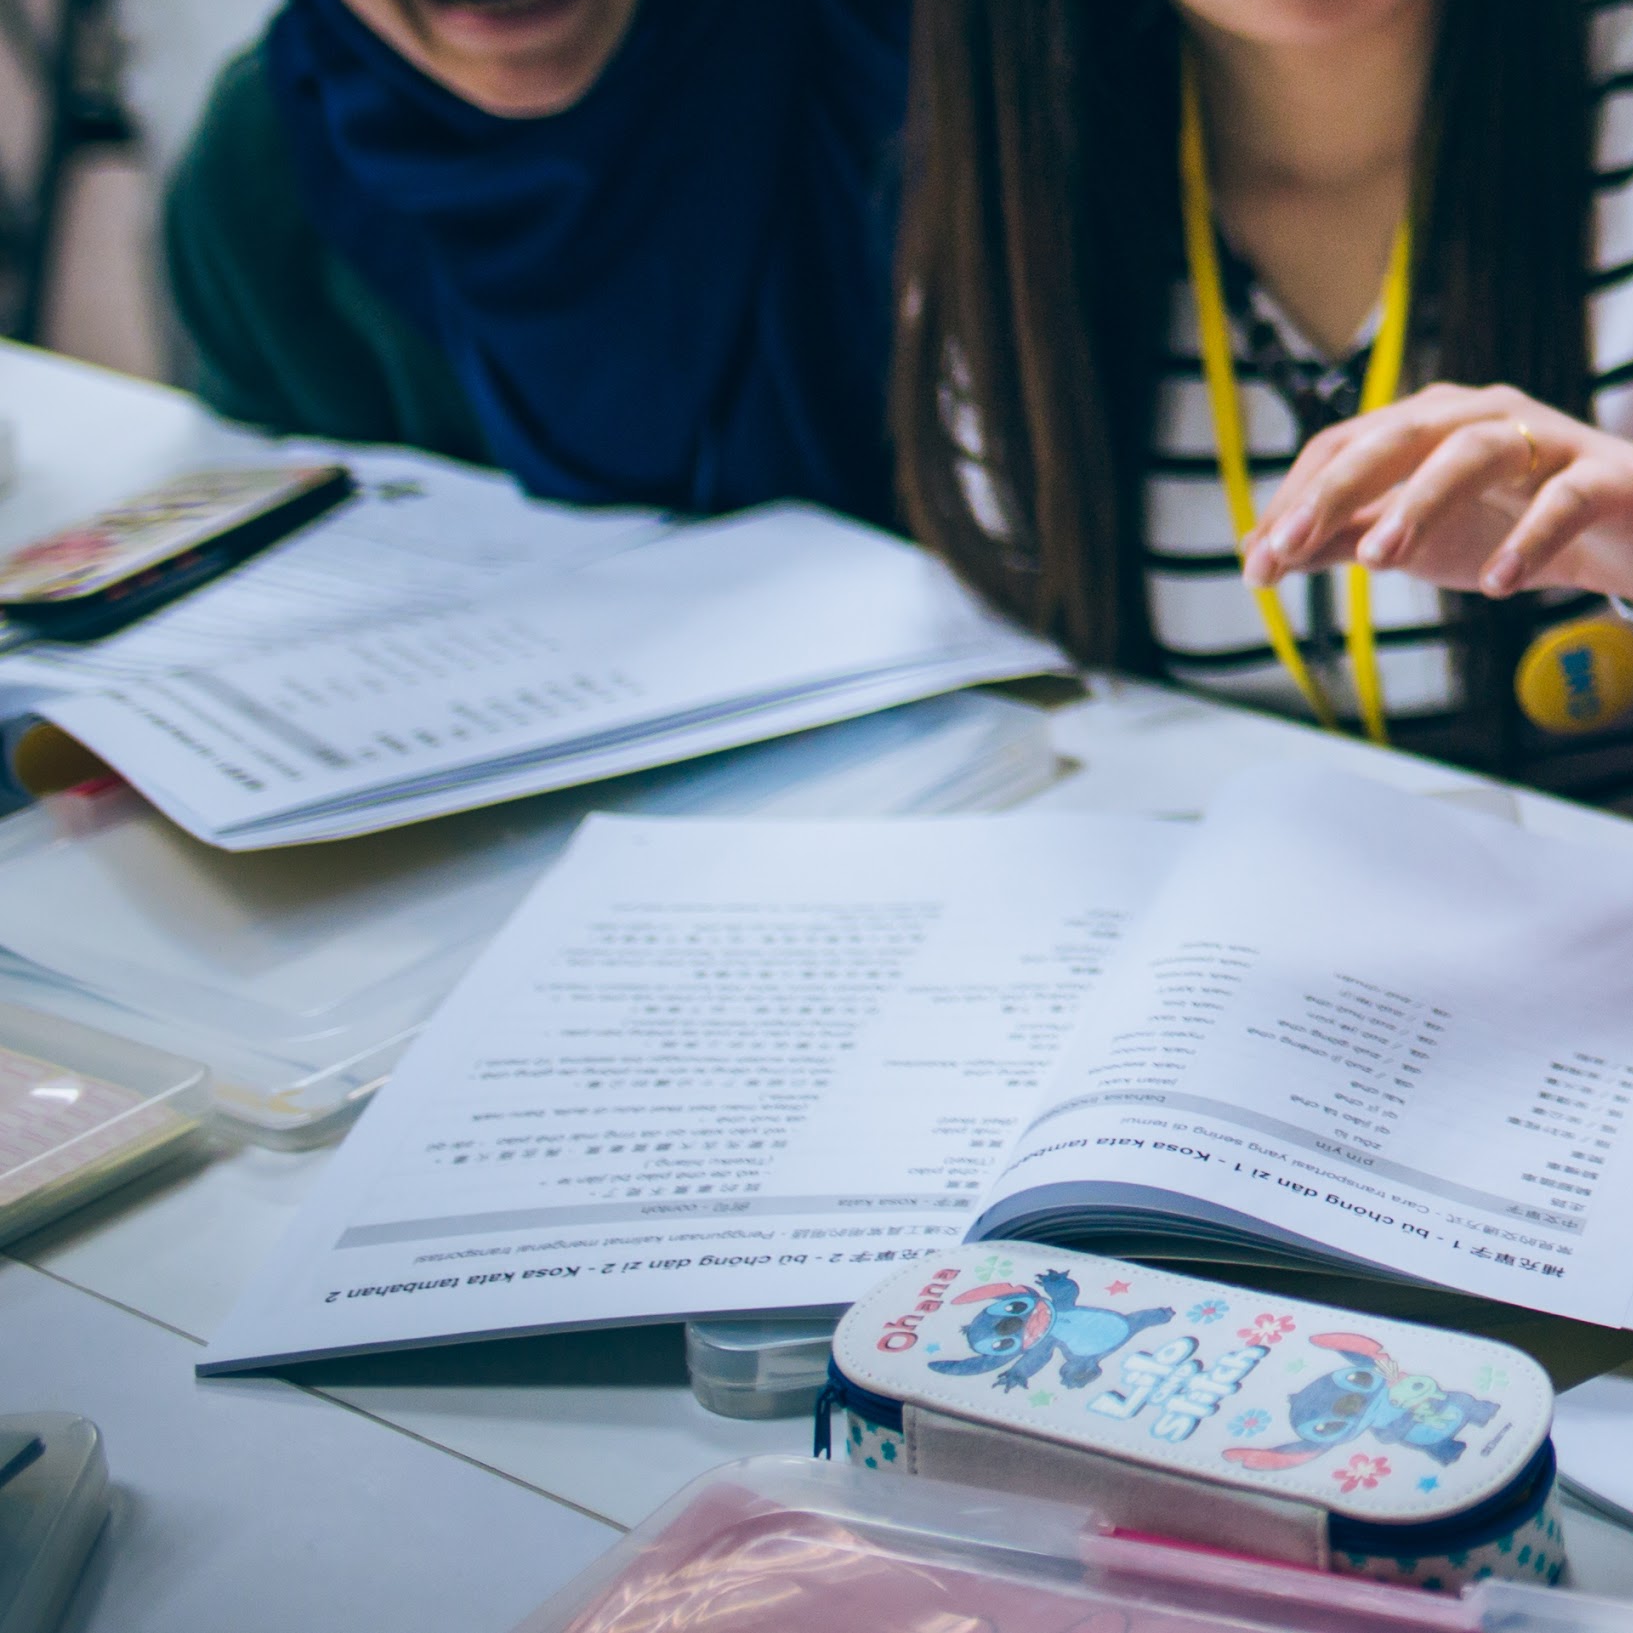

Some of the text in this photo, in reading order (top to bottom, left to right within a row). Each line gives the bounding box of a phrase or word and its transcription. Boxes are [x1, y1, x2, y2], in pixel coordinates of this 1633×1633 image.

[1121, 1117, 1169, 1129] temui
[1172, 1122, 1189, 1131] di
[1096, 1137, 1145, 1149] kata
[1192, 1125, 1244, 1147] sering
[1152, 1141, 1211, 1162] Kosa
[1247, 1141, 1289, 1162] yang
[1234, 1162, 1242, 1172] 1
[1251, 1168, 1271, 1180] zì
[1277, 1177, 1318, 1197] dān
[1290, 1159, 1386, 1199] transportasi
[1324, 1193, 1395, 1225] chōng
[1391, 1194, 1430, 1215] Cara
[601, 1235, 664, 1248] kalimat
[667, 1229, 776, 1242] Penggunaan
[1452, 1240, 1460, 1249] 1
[413, 1246, 512, 1265] transportasi
[1469, 1246, 1565, 1279] 補充單字
[521, 1265, 581, 1280] Kosa
[600, 1262, 617, 1275] 2
[346, 1277, 460, 1299] tambahan
[466, 1271, 516, 1286] kata
[324, 1290, 342, 1304] 2
[876, 1267, 962, 1354] Ohana
[1088, 1335, 1200, 1423] Lilo
[1150, 1341, 1271, 1444] Stitch
